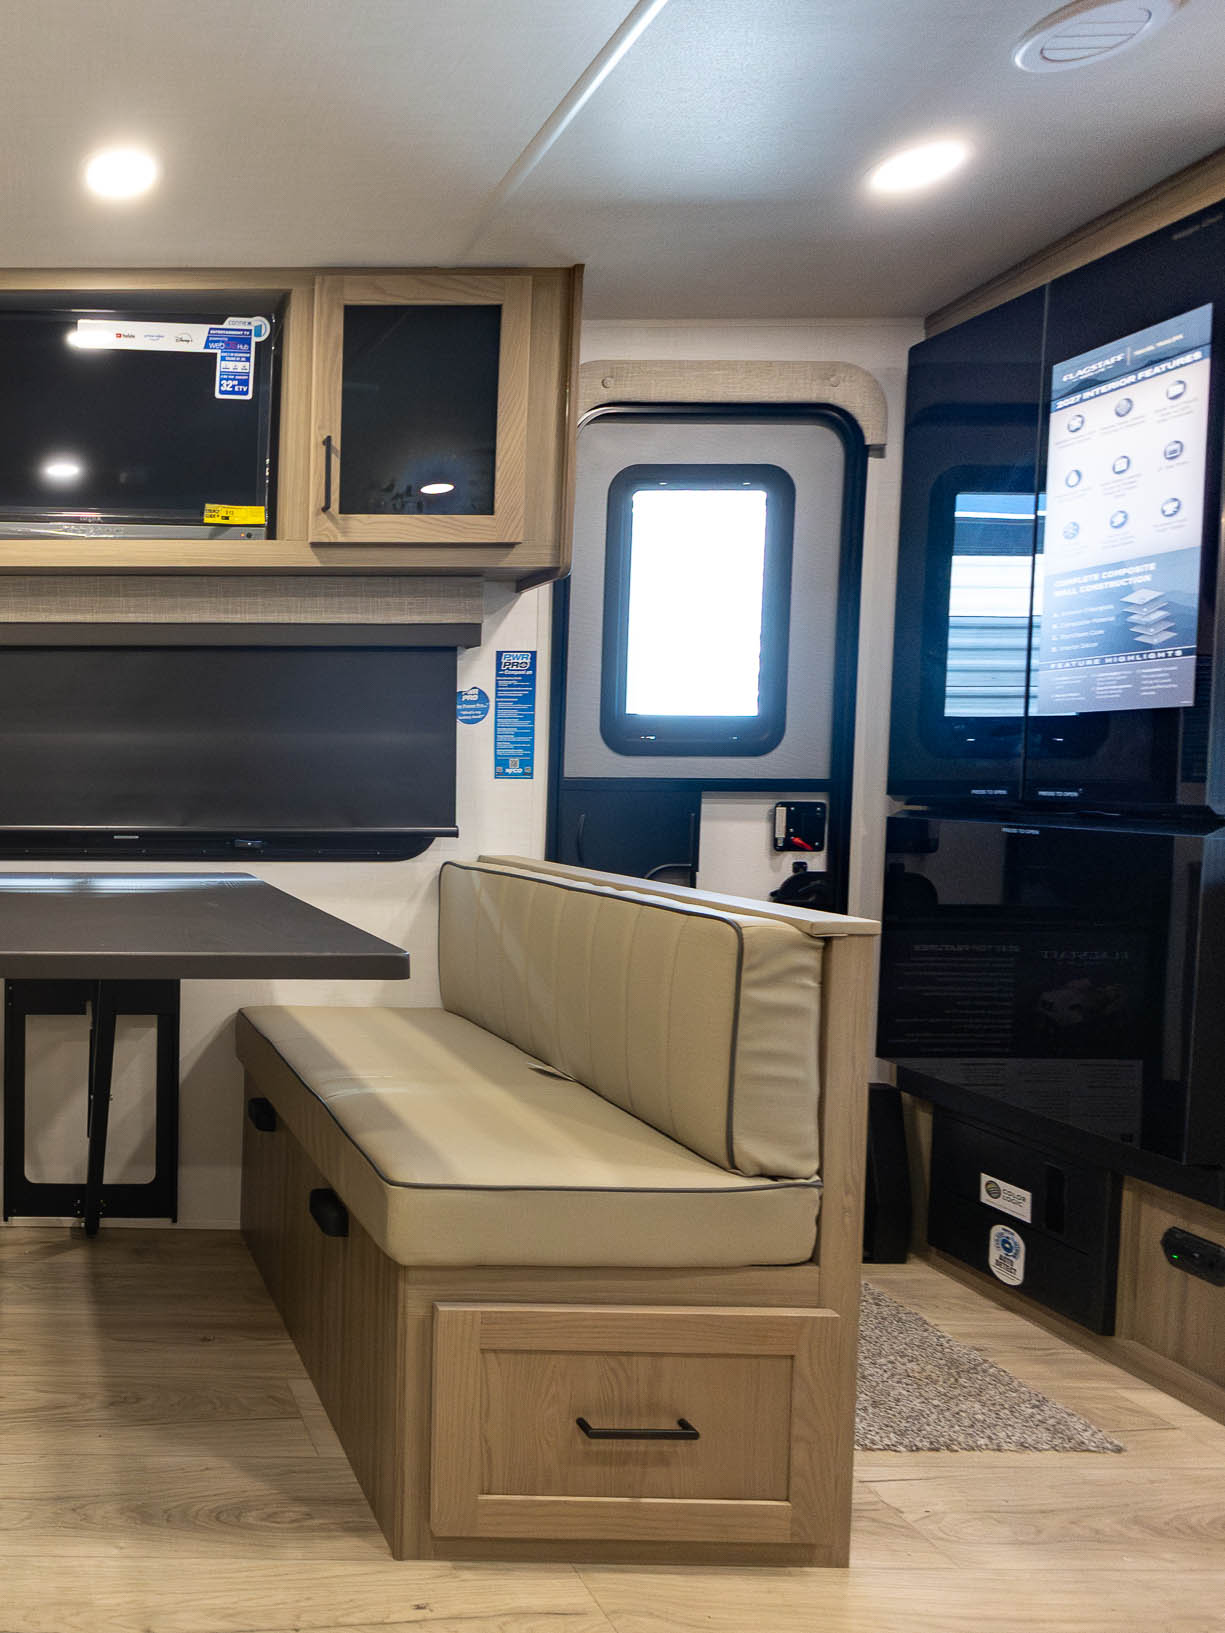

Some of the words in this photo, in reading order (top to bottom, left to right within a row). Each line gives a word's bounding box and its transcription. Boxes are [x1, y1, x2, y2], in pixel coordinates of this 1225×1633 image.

[1062, 352, 1125, 382] FLAGSTAFF
[1082, 375, 1137, 400] INTERIOR
[1137, 351, 1203, 380] FEATURES
[503, 653, 529, 661] PWR
[503, 661, 529, 669] PRO
[1050, 657, 1101, 669] FEATURE
[1105, 650, 1183, 664] HIGHLIGHTS
